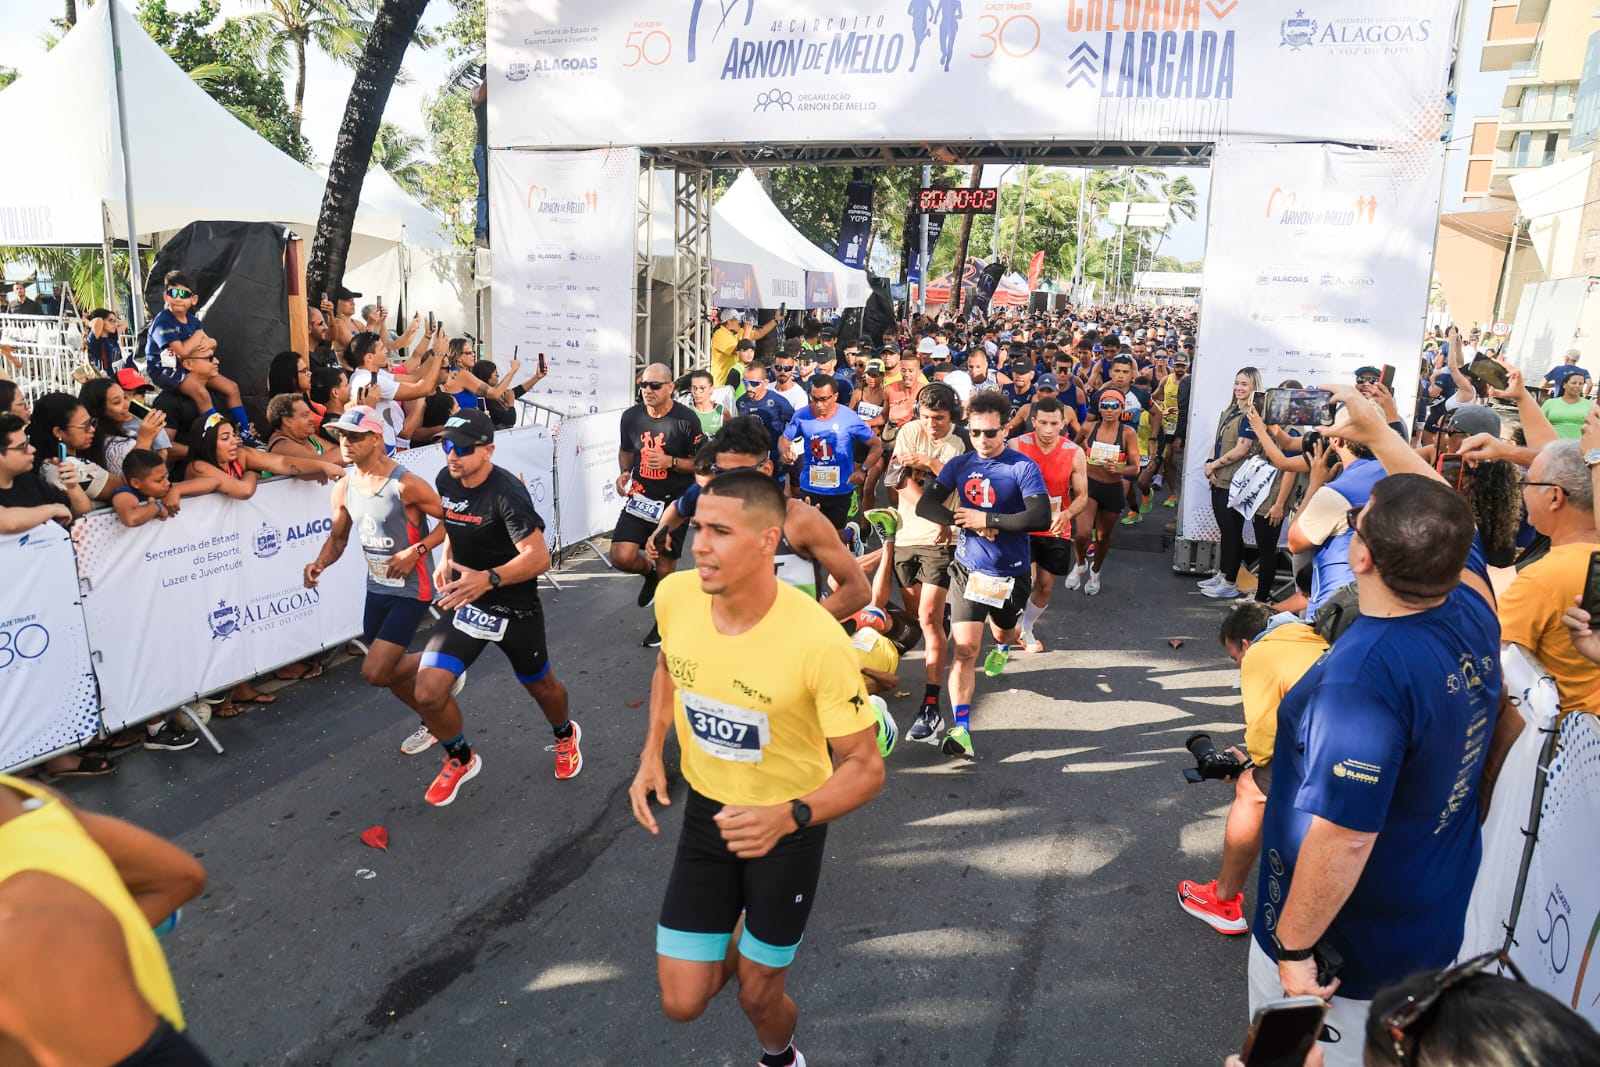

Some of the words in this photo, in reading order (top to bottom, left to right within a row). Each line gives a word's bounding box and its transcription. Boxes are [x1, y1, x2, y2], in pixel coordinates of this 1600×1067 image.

[789, 14, 885, 32] CIRCUITO
[1317, 19, 1431, 43] ALAGOAS
[623, 29, 672, 67] 50
[969, 14, 1041, 59] 30
[533, 57, 598, 72] ALAGOAS
[720, 37, 804, 80] ARNON
[802, 42, 828, 71] DE
[824, 31, 904, 75] MELLO
[1100, 30, 1236, 99] LARGADA
[797, 92, 851, 102] ORGANIZAÇÃO
[797, 102, 831, 111] ARNON
[832, 102, 844, 111] DE
[845, 101, 876, 111] MELLO
[1280, 208, 1313, 225] ARNON
[1323, 209, 1355, 225] MELLO
[1271, 275, 1309, 283] ALAGOAS
[286, 517, 333, 542] ALAGO
[145, 543, 197, 562] Secretaria
[198, 539, 210, 550] de
[211, 531, 240, 546] Estado
[193, 555, 206, 566] do
[162, 573, 189, 588] Lazer
[190, 571, 197, 581] e
[199, 559, 243, 579] Juventude
[242, 587, 320, 627] ALAGOAS
[466, 608, 497, 627] 1702
[258, 623, 276, 634] VOZ
[279, 617, 291, 627] DO
[694, 712, 748, 742] 3107
[1537, 891, 1570, 974] 50
